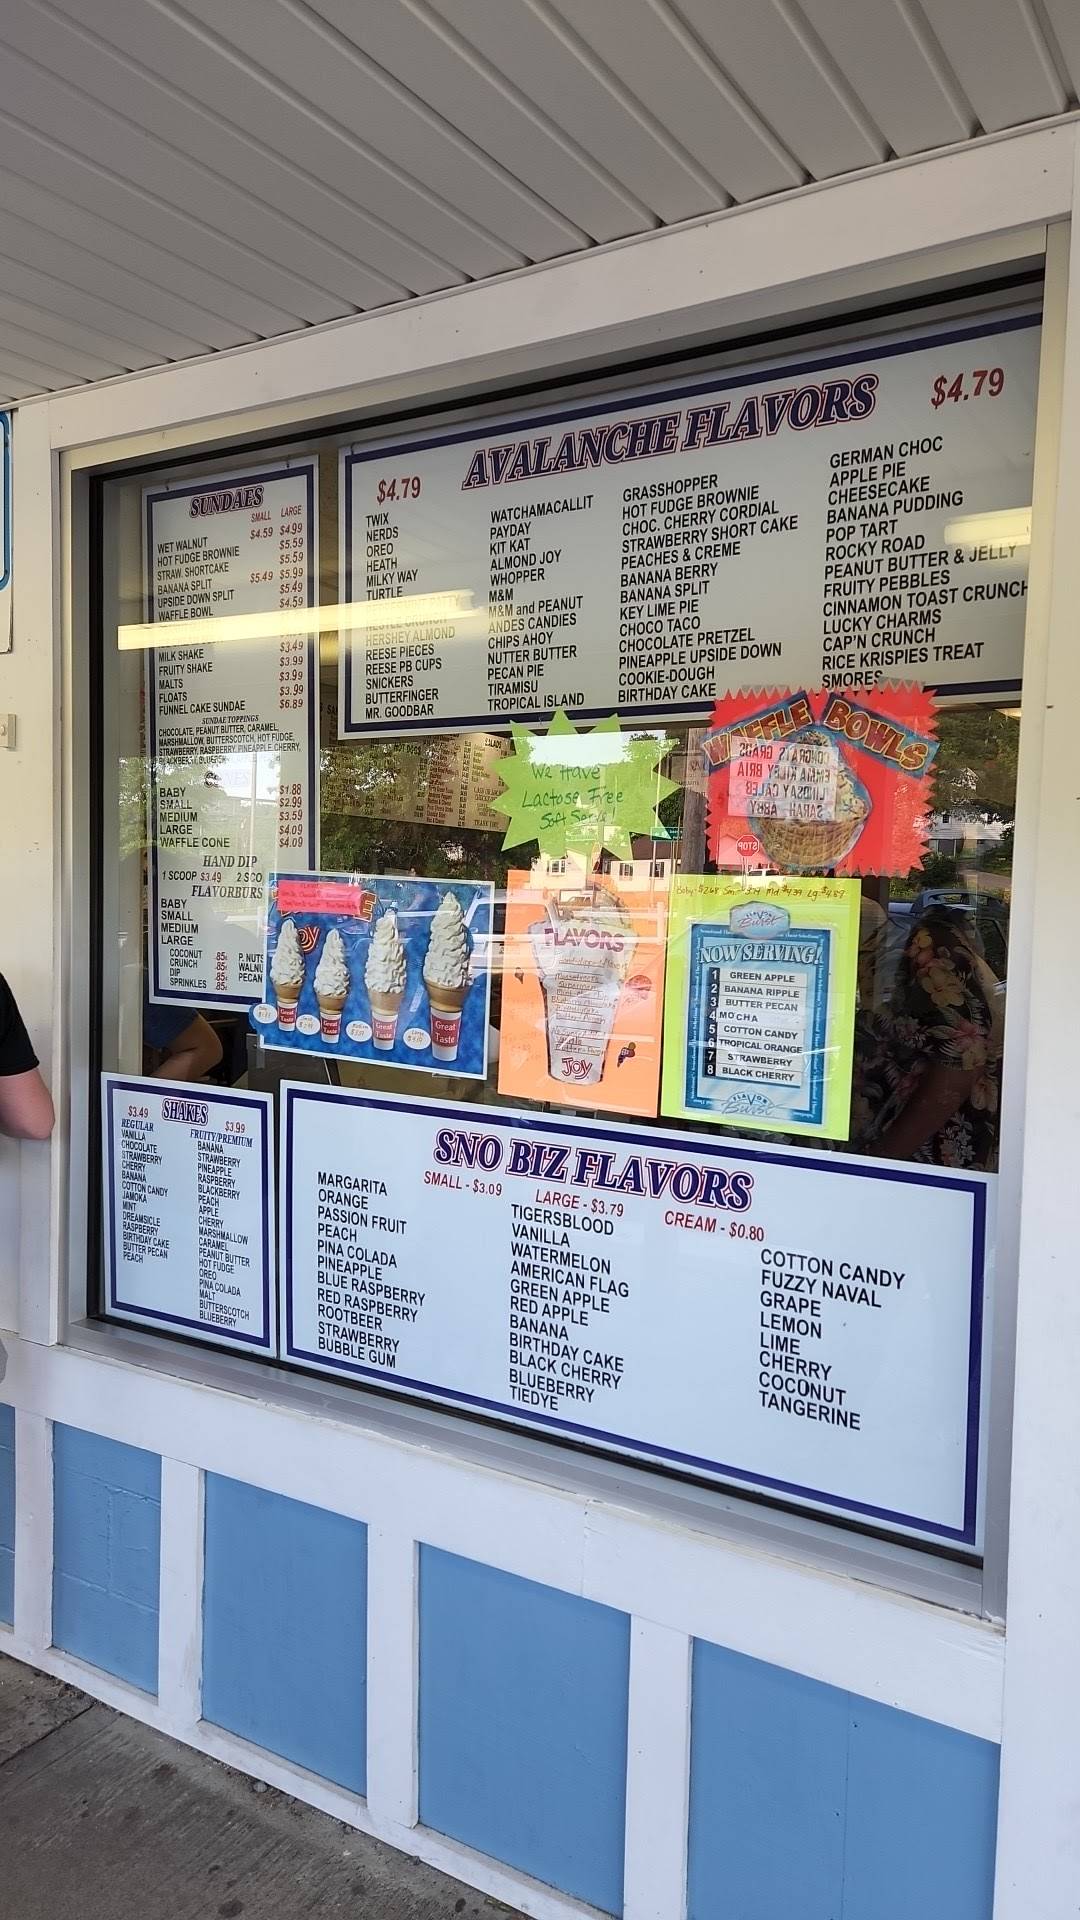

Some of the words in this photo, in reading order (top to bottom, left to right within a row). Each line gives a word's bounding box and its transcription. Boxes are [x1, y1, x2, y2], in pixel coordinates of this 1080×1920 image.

[931, 368, 1005, 409] $4.79
[461, 411, 682, 491] AVALANCHE
[680, 373, 880, 450] FLAVORS
[830, 444, 893, 469] GERMAN
[899, 435, 942, 457] CHOC
[377, 472, 420, 505] $4.79
[623, 473, 717, 502] GRASSHOPPER
[828, 475, 929, 505] CHEESECAKE
[189, 485, 264, 518] SUNDAES
[281, 504, 301, 517] LARGE
[491, 494, 593, 523] WATCHAMACALLIT
[622, 503, 647, 519] HOT
[651, 495, 692, 515] FUDGE
[697, 485, 758, 508] BROWNIE
[251, 510, 271, 522] SMALL
[365, 512, 388, 528] TWIX
[250, 526, 273, 540] $4.59
[279, 521, 302, 536] $4.99
[366, 525, 398, 542] NERDS
[490, 521, 530, 539] PAYDAY
[622, 528, 707, 553] STRAWBERRY
[711, 521, 756, 541] SHORT
[760, 514, 797, 534] CAKE
[157, 541, 174, 554] WET
[175, 536, 207, 551] WALNUT
[366, 542, 393, 558] OREO
[366, 556, 397, 572] HEATH
[490, 552, 536, 571] ALMOND
[539, 549, 561, 564] JOY
[825, 558, 883, 579] PEANUT
[888, 550, 948, 572] BUTTER
[953, 548, 964, 564] &
[969, 542, 1016, 562] JELLY
[250, 570, 273, 583] $5.49
[279, 565, 303, 580] $5.99
[366, 571, 394, 587] MILKY
[397, 568, 417, 583] WAY
[490, 567, 544, 586] WHOPPER
[157, 581, 189, 595] BANANA
[190, 578, 212, 591] SPLIT
[823, 594, 901, 617] CINNAMON
[906, 587, 958, 608] TOAST
[158, 650, 175, 662] MILK
[178, 648, 203, 660] SHAKE
[488, 649, 529, 665] NUTTER
[533, 644, 576, 661] BUTTER
[159, 678, 183, 689] MALTS
[366, 674, 413, 690] SNICKERS
[619, 665, 714, 686] COOKIE-DOUGH
[159, 691, 187, 703] FLOATS
[365, 687, 438, 704] BUTTERFINGER
[159, 704, 188, 715] FUNNEL
[190, 702, 211, 713] CAKE
[213, 700, 245, 712] SUNDAE
[703, 700, 813, 766] WAFFLE
[823, 699, 928, 770] BOWLS
[560, 765, 600, 781] Have
[522, 788, 580, 808] Lactose
[588, 785, 624, 803] Free
[159, 812, 197, 822] MEDIUM
[540, 812, 566, 830] Soft
[160, 824, 192, 834] LARGE
[160, 837, 199, 847] WAFFLE
[201, 837, 229, 847] CONE
[202, 855, 234, 867] HAND
[237, 855, 257, 867] DIP
[544, 928, 624, 952] FLAVORS
[169, 948, 202, 959] COCONUT
[700, 944, 741, 963] NOW
[742, 943, 823, 965] SERVING!
[169, 977, 206, 988] SPRINKLES
[712, 970, 717, 978] 1
[730, 971, 762, 981] GREEN
[765, 974, 795, 983] APPLE
[711, 984, 717, 993] 2
[725, 985, 763, 996] BANANA
[766, 988, 800, 998] RIPPLE
[710, 997, 717, 1007] 3
[726, 998, 763, 1009] BUTTER
[766, 1001, 798, 1012] PECAN
[709, 1011, 716, 1020] 4
[435, 1021, 456, 1031] Great
[709, 1024, 716, 1034] 5
[724, 1025, 762, 1036] COTTON
[765, 1029, 798, 1040] CANDY
[435, 1033, 456, 1044] Taste
[708, 1038, 715, 1047] 6
[719, 1038, 762, 1050] TROPICAL
[764, 1043, 803, 1053] ORANGE
[708, 1051, 714, 1061] 7
[728, 1053, 792, 1067] STRAWBERRY
[707, 1065, 714, 1074] 8
[722, 1066, 753, 1077] BLACK
[755, 1070, 794, 1081] CHERRY
[128, 1104, 148, 1119] $3.49
[162, 1097, 208, 1125] SHAKES
[121, 1118, 153, 1131] REGULAR
[225, 1120, 245, 1134] $3.99
[121, 1128, 145, 1141] VANILLA
[190, 1128, 252, 1147] FRUITY/PREMIUM
[121, 1139, 157, 1153] CHOCOLATE
[433, 1128, 504, 1170] SNO
[505, 1138, 573, 1185] BIZ
[571, 1147, 755, 1212] FLAVORS
[121, 1180, 145, 1193] COTTON
[147, 1184, 168, 1197] CANDY
[318, 1171, 387, 1196] MARGARITA
[424, 1170, 461, 1189] SMALL
[472, 1178, 501, 1197] $3.09
[122, 1200, 136, 1211] MINT
[535, 1188, 579, 1209] LARGE
[591, 1198, 623, 1217] $3.79
[122, 1210, 160, 1227] DREAMSICLE
[318, 1205, 367, 1227] PASSION
[372, 1215, 406, 1235] FRUIT
[511, 1203, 613, 1236] TIGERSBLOOD
[665, 1210, 716, 1233] CREAM
[729, 1221, 764, 1242] $0.80
[198, 1226, 248, 1245] MARSHMALLOW
[512, 1222, 570, 1247] VANILLA
[511, 1241, 610, 1274] WATERMELON
[761, 1247, 832, 1276] COTTON
[839, 1262, 905, 1290] CANDY
[510, 1259, 584, 1288] AMERICAN
[590, 1275, 628, 1298] FLAG
[762, 1269, 816, 1295] FUZZY
[822, 1280, 881, 1308] NAVAL
[199, 1299, 249, 1320] BUTTERSCOTCH
[760, 1289, 820, 1317] GRAPE
[199, 1310, 236, 1327] BLUEBERRY
[318, 1303, 382, 1331] ROOTBEER
[760, 1311, 821, 1339] LEMON
[509, 1384, 558, 1411] TIEDYE
[759, 1390, 860, 1430] TANGERINE
